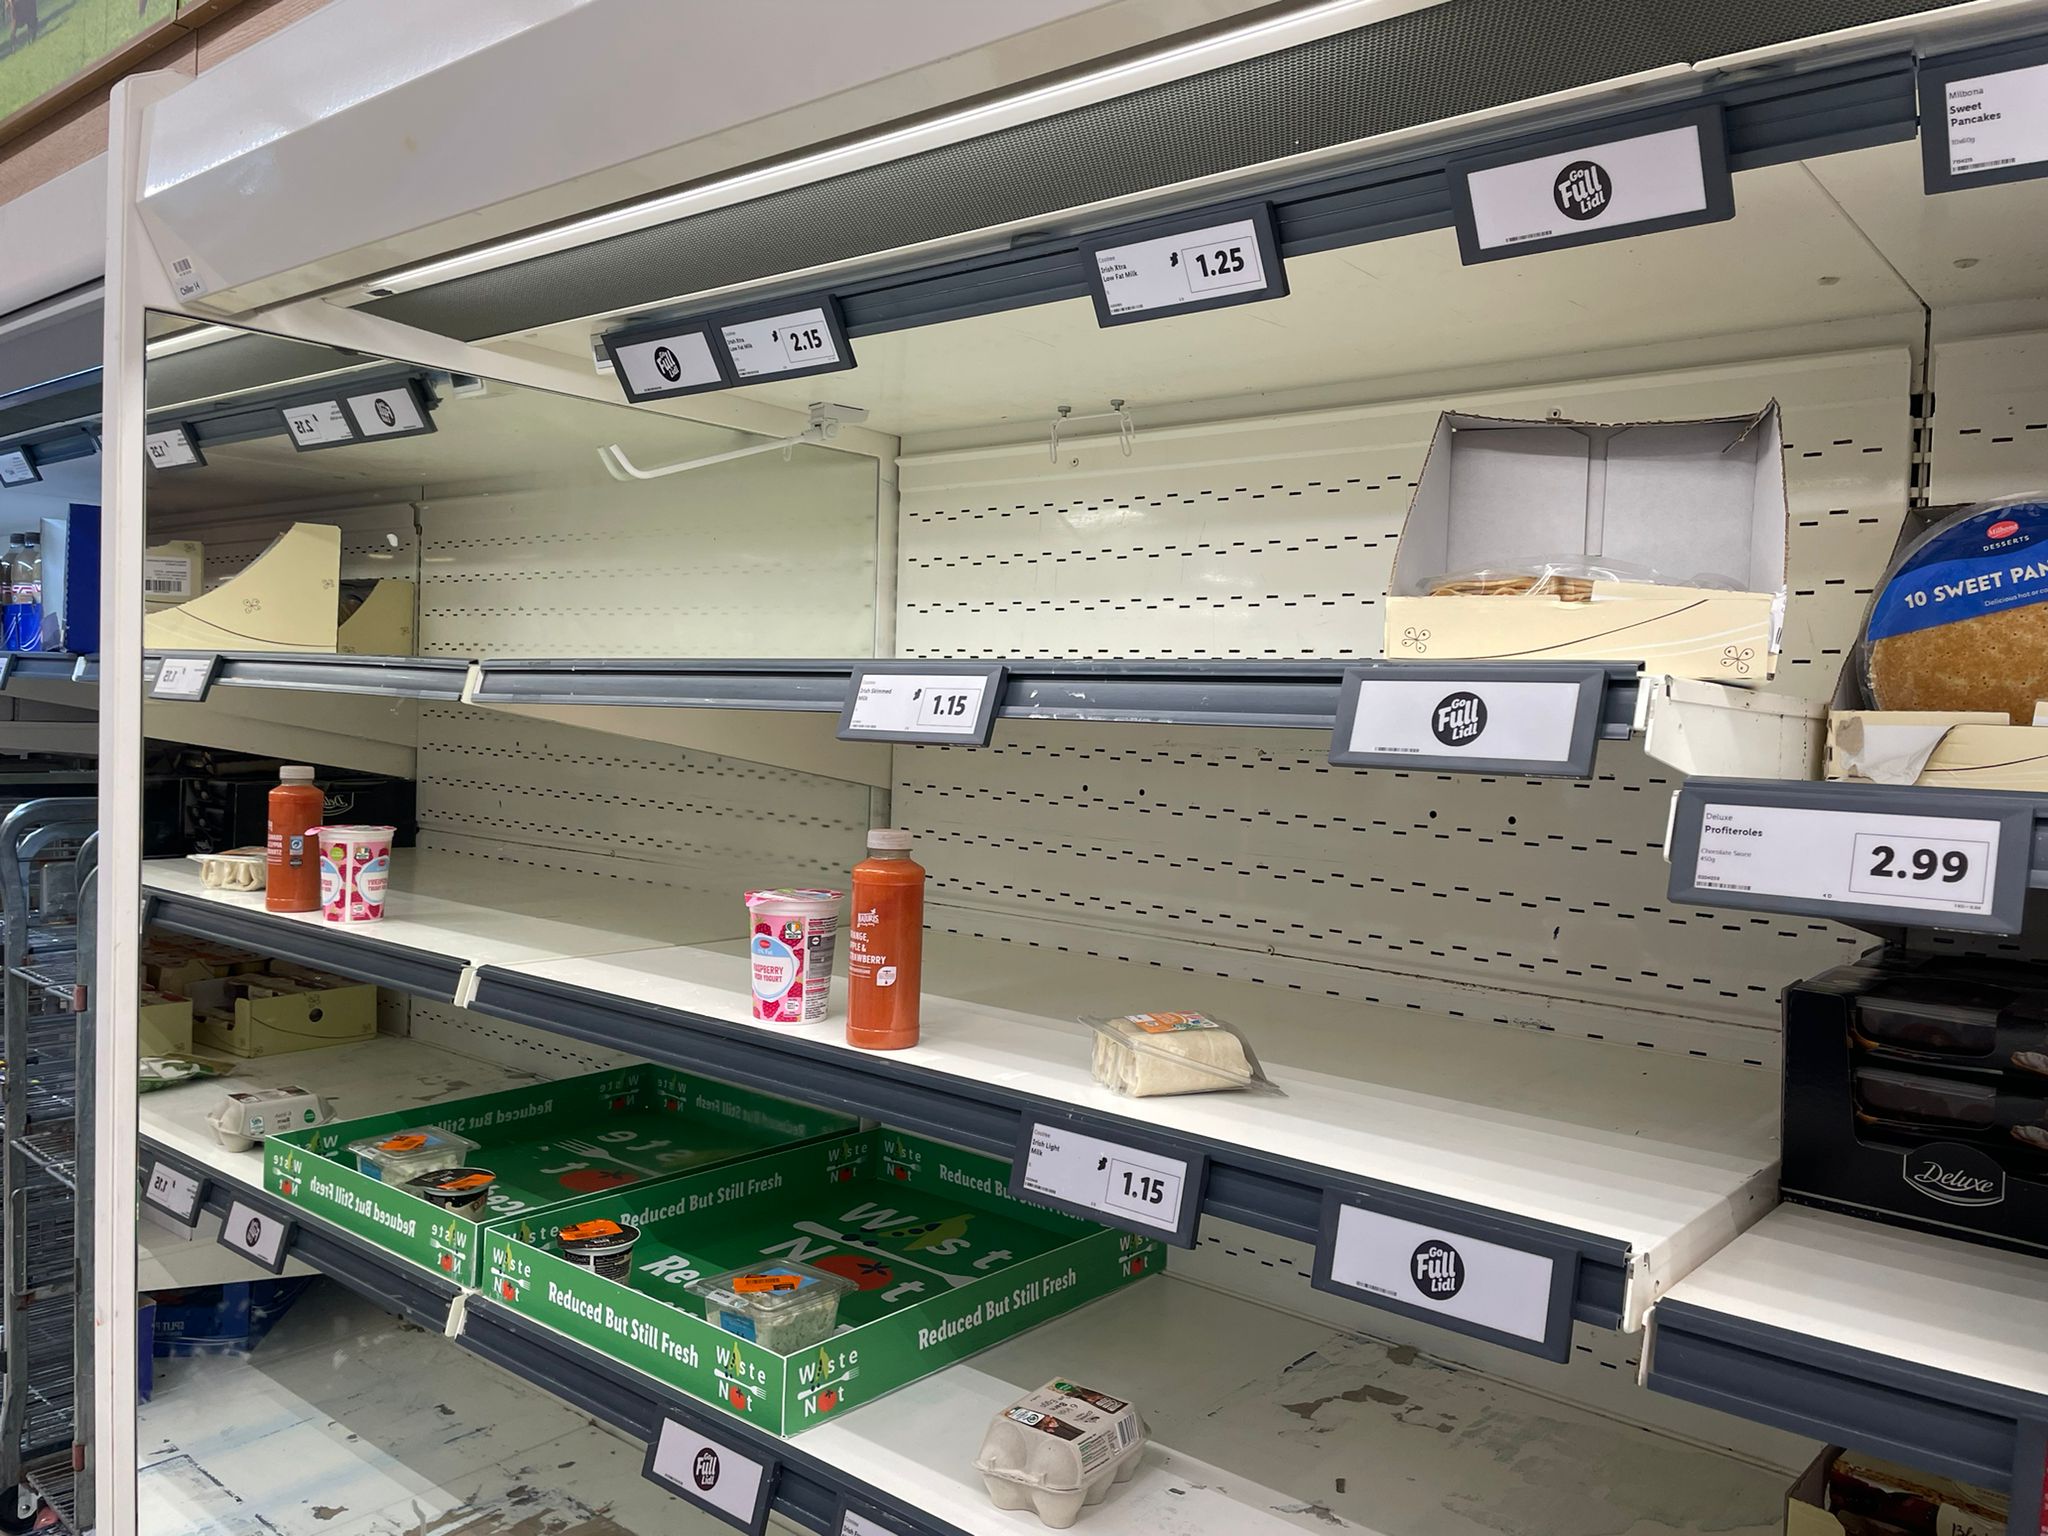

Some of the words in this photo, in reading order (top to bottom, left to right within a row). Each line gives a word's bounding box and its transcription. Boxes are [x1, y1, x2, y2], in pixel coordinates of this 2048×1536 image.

[1949, 89, 1984, 99] Milbona
[1950, 102, 1982, 114] Sweet
[1951, 113, 2001, 127] Pancakes
[1569, 170, 1584, 182] Go
[1558, 166, 1602, 209] Full
[1580, 191, 1606, 214] Lidl
[1101, 265, 1115, 274] Irish
[1114, 263, 1127, 272] Xtra
[1195, 247, 1245, 278] 1.25
[1103, 274, 1115, 282] Low
[1115, 272, 1125, 280] Fat
[1125, 270, 1138, 279] Milk
[789, 328, 823, 352] 2.15
[656, 350, 676, 375] Full
[1983, 535, 2030, 552] DESSERTS
[1904, 591, 1927, 609] 10
[1933, 571, 2003, 603] SWEET
[1984, 594, 2018, 607] Delicious
[933, 695, 967, 716] 1.15
[1451, 698, 1466, 710] Go
[1438, 699, 1479, 732] Full
[1452, 725, 1477, 740] Lidl
[1706, 812, 1733, 821] Deluxe
[1705, 825, 1763, 837] Profiteroles
[1870, 845, 1969, 883] 2.99
[1031, 1147, 1043, 1157] Milk
[1032, 1138, 1045, 1147] Irish
[1046, 1141, 1060, 1152] Light
[939, 1163, 992, 1195] Reduced
[1914, 1161, 1994, 1193] Deluxe
[1123, 1171, 1165, 1204] 1.15
[620, 1197, 685, 1228] Reduced
[689, 1188, 714, 1212] But
[716, 1180, 745, 1202] Still
[748, 1172, 783, 1195] Fresh
[1429, 1246, 1443, 1258] Go
[1416, 1251, 1456, 1280] Full
[1431, 1278, 1456, 1292] Lidl
[918, 1304, 982, 1351] Reduced
[986, 1294, 1010, 1322] But
[1013, 1284, 1040, 1310] Still
[1042, 1267, 1076, 1297] Fresh
[548, 1281, 602, 1325] Reduced
[606, 1306, 628, 1335] But
[631, 1317, 658, 1349] Still
[661, 1332, 699, 1369] Fresh
[696, 1455, 717, 1476] Full
[701, 1475, 715, 1486] Lidl
